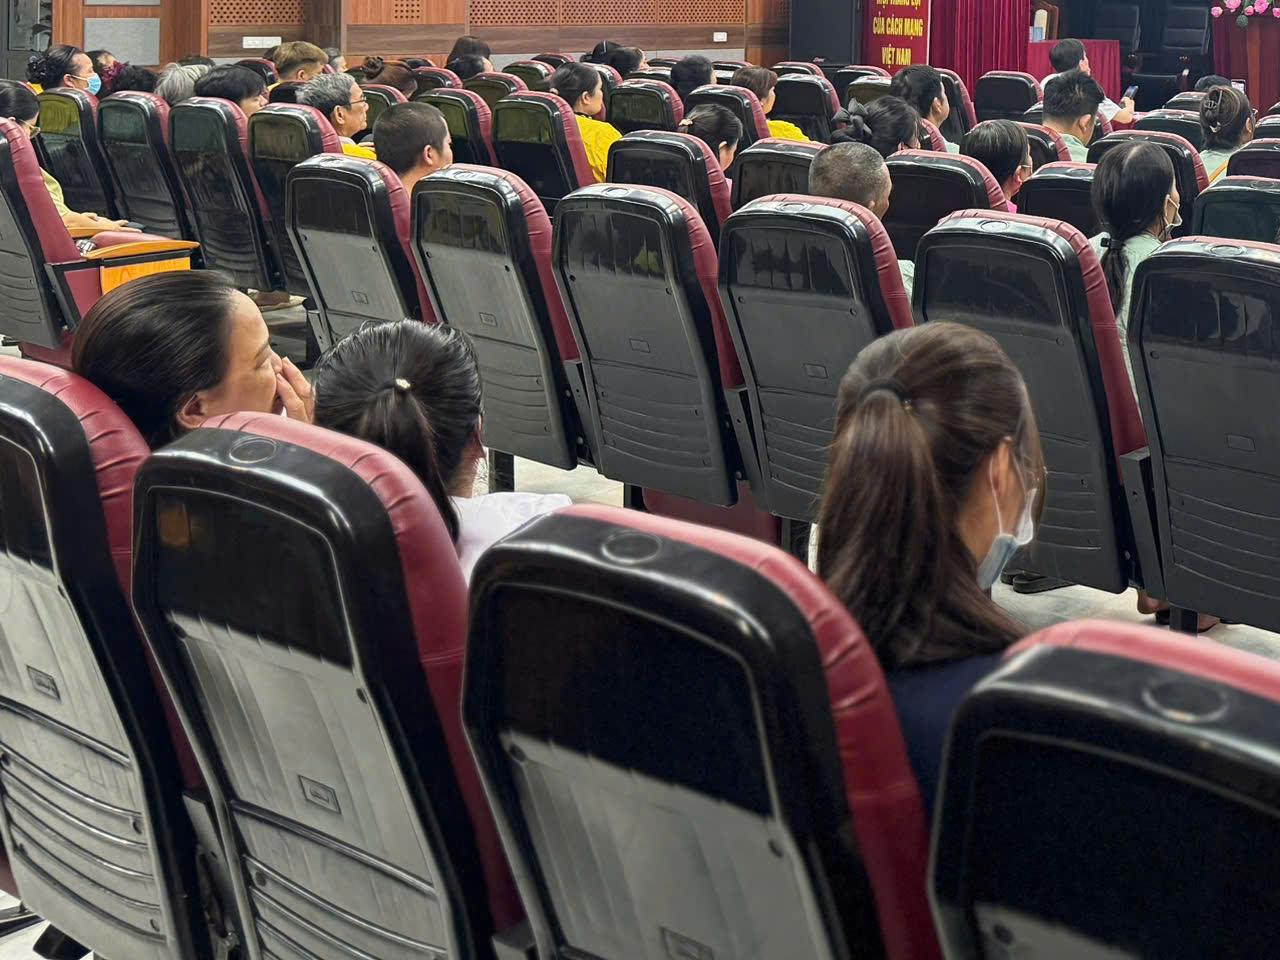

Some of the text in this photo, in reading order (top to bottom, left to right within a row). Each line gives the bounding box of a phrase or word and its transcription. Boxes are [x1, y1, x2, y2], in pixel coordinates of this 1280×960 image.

[873, 11, 923, 40] CỦA CÁCH MẠNG
[882, 43, 911, 69] VIỆT NAM
